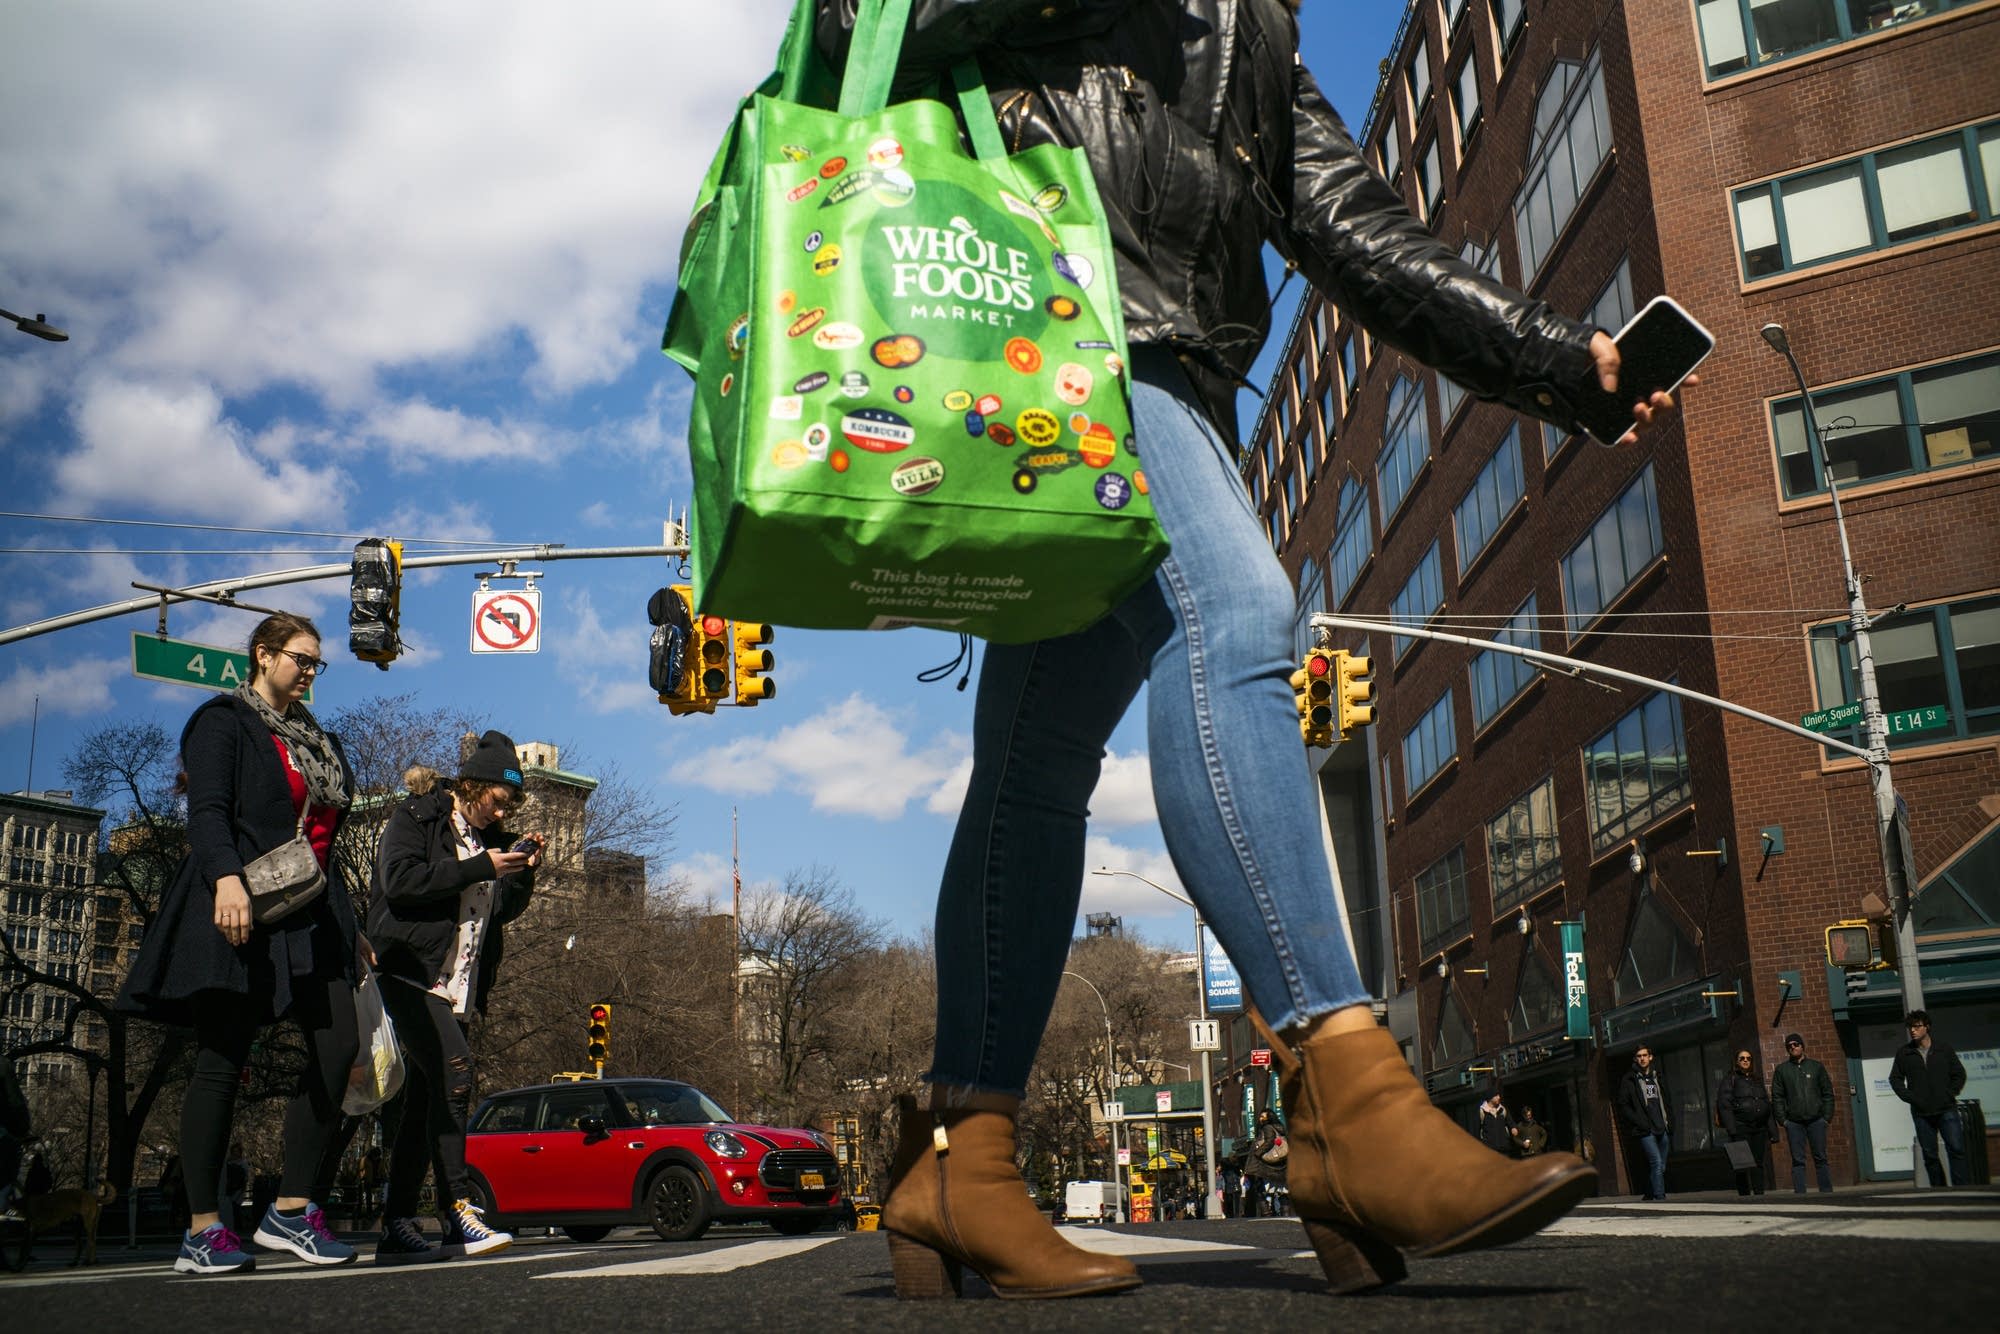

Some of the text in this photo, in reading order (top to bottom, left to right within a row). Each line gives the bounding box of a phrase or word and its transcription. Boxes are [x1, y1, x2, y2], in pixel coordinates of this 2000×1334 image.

[881, 224, 1032, 282] WHOLE
[892, 262, 1034, 311] FOODS
[911, 305, 1015, 328] MARKET
[851, 422, 907, 439] KOMBUCHA
[896, 467, 940, 487] BULK
[872, 568, 1024, 587] This bag is made
[850, 581, 1032, 602] from 100% recycled
[867, 597, 999, 611] plastic bottles.
[187, 653, 207, 678] 4
[1804, 705, 1860, 727] Union Square
[1895, 709, 1937, 731] E 14 St
[1211, 979, 1236, 988] UNION
[1565, 952, 1585, 1008] FedEx
[1208, 987, 1240, 996] SQUARE
